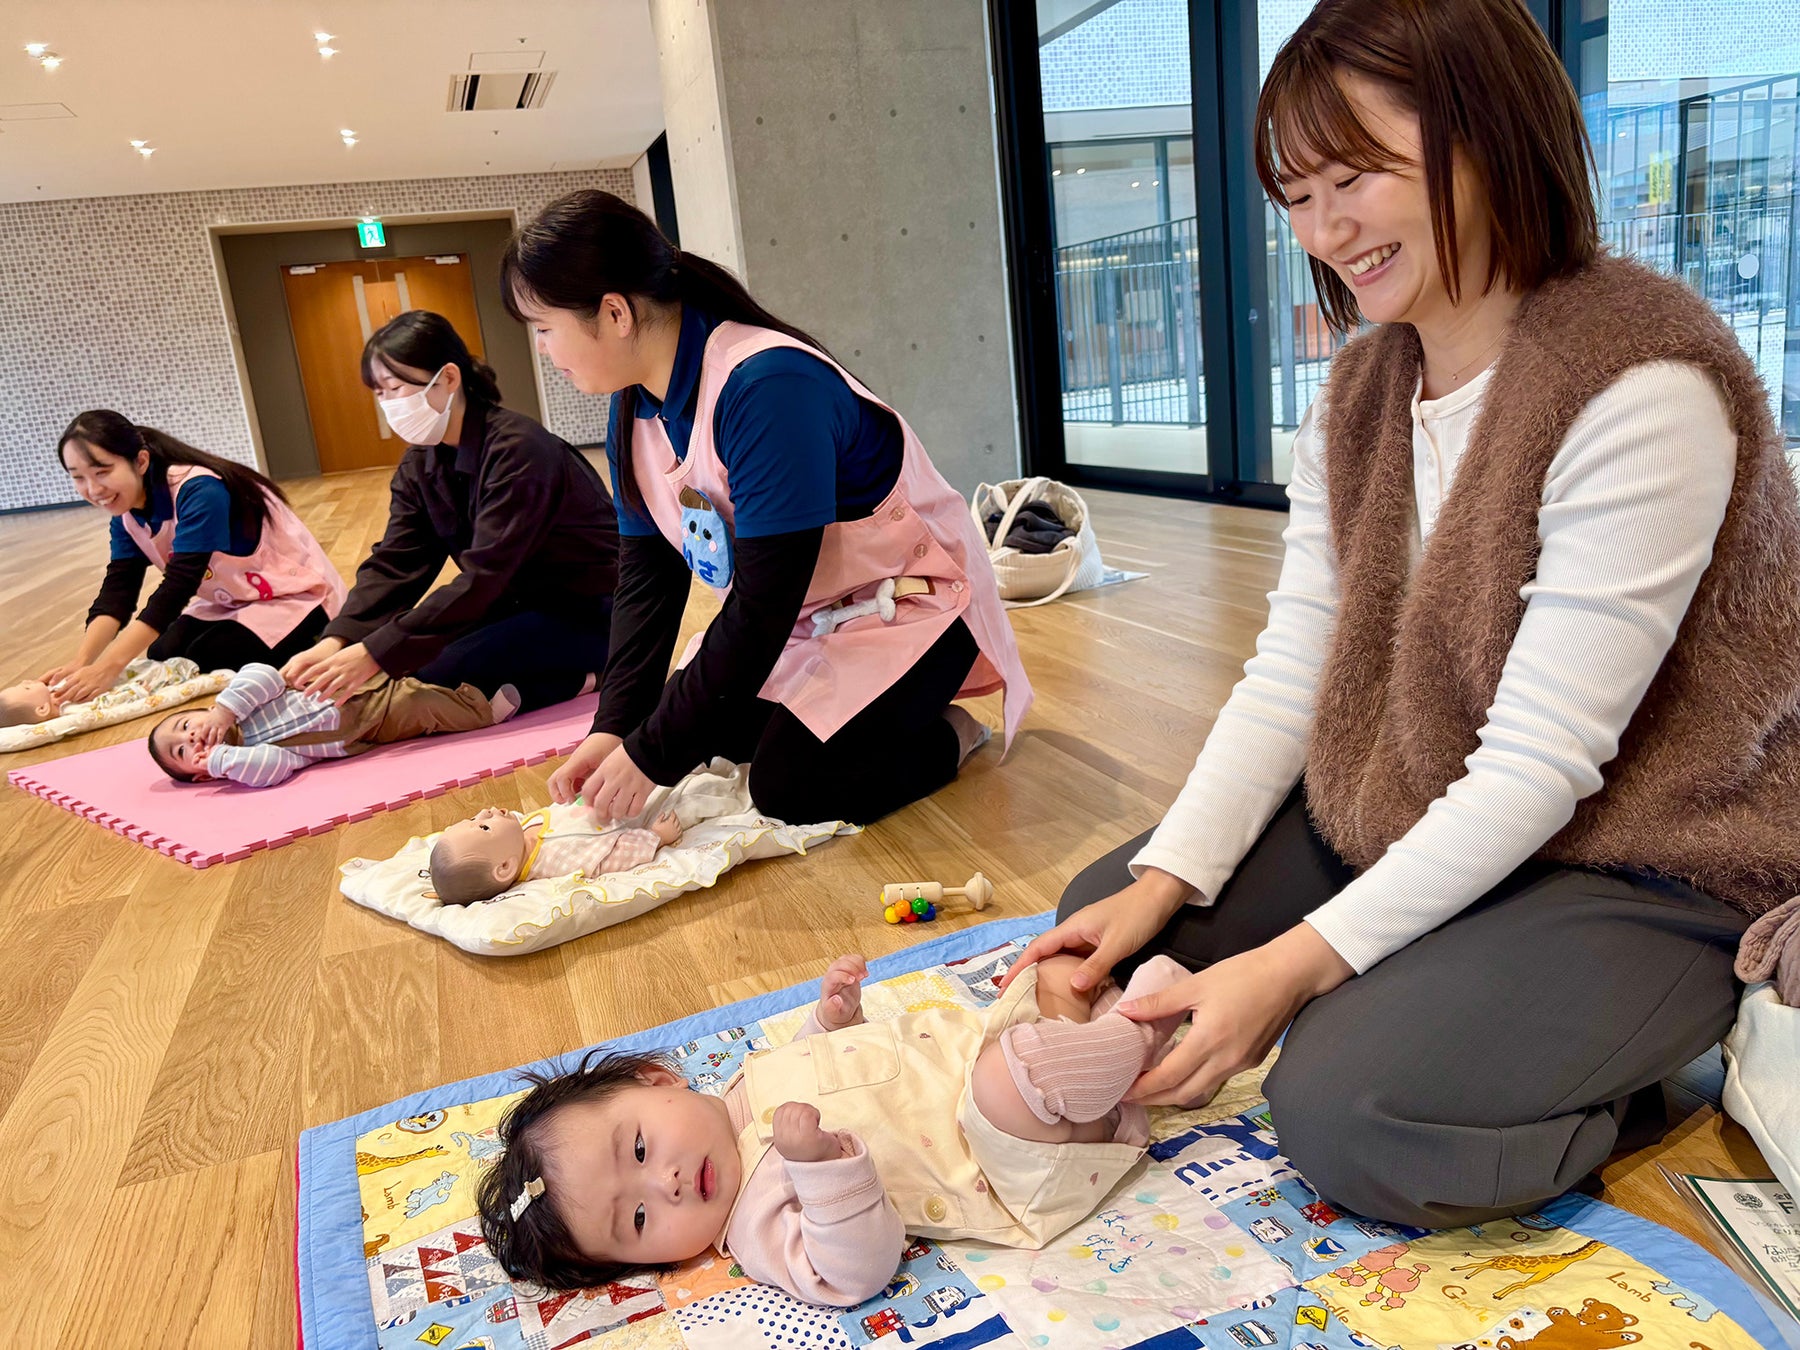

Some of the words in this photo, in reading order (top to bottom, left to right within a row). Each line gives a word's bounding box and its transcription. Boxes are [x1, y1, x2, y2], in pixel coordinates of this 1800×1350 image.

[383, 1180, 402, 1210] Lamb
[1605, 1271, 1652, 1303] Lamb
[1313, 1291, 1350, 1323] oodle
